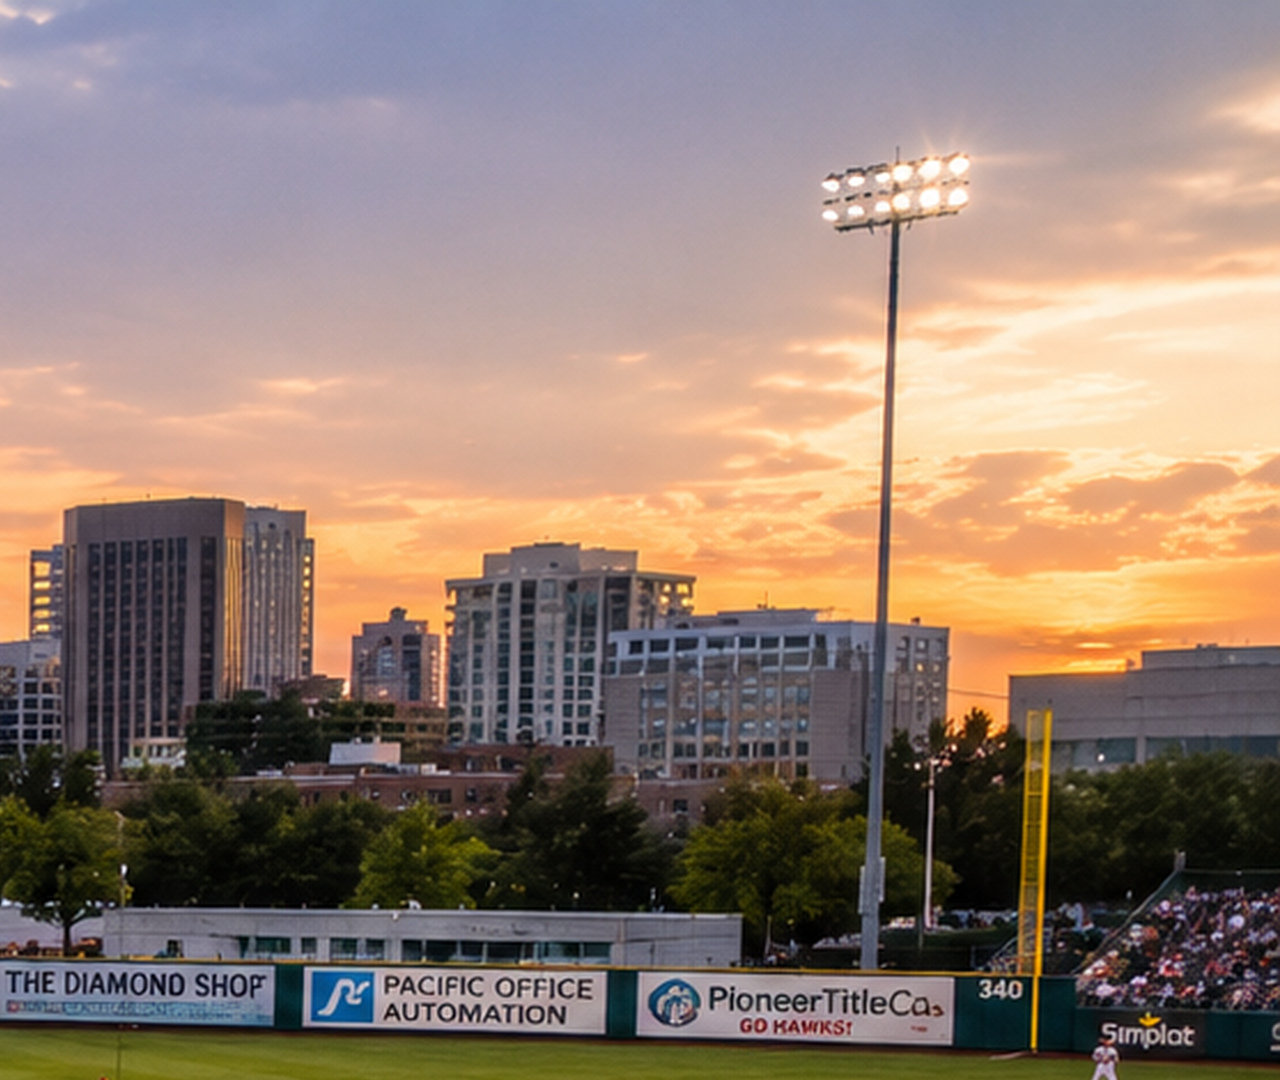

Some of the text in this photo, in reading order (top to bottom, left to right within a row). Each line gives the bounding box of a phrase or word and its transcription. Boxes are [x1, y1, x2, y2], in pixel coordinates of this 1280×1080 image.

[5, 970, 55, 993] THE
[64, 970, 186, 997] DIAMOND
[383, 974, 594, 1001] PACIFIC OFFICE
[978, 980, 1024, 999] 340
[383, 1002, 568, 1025] AUTOMATION
[740, 1018, 853, 1036] GO HAWKS!
